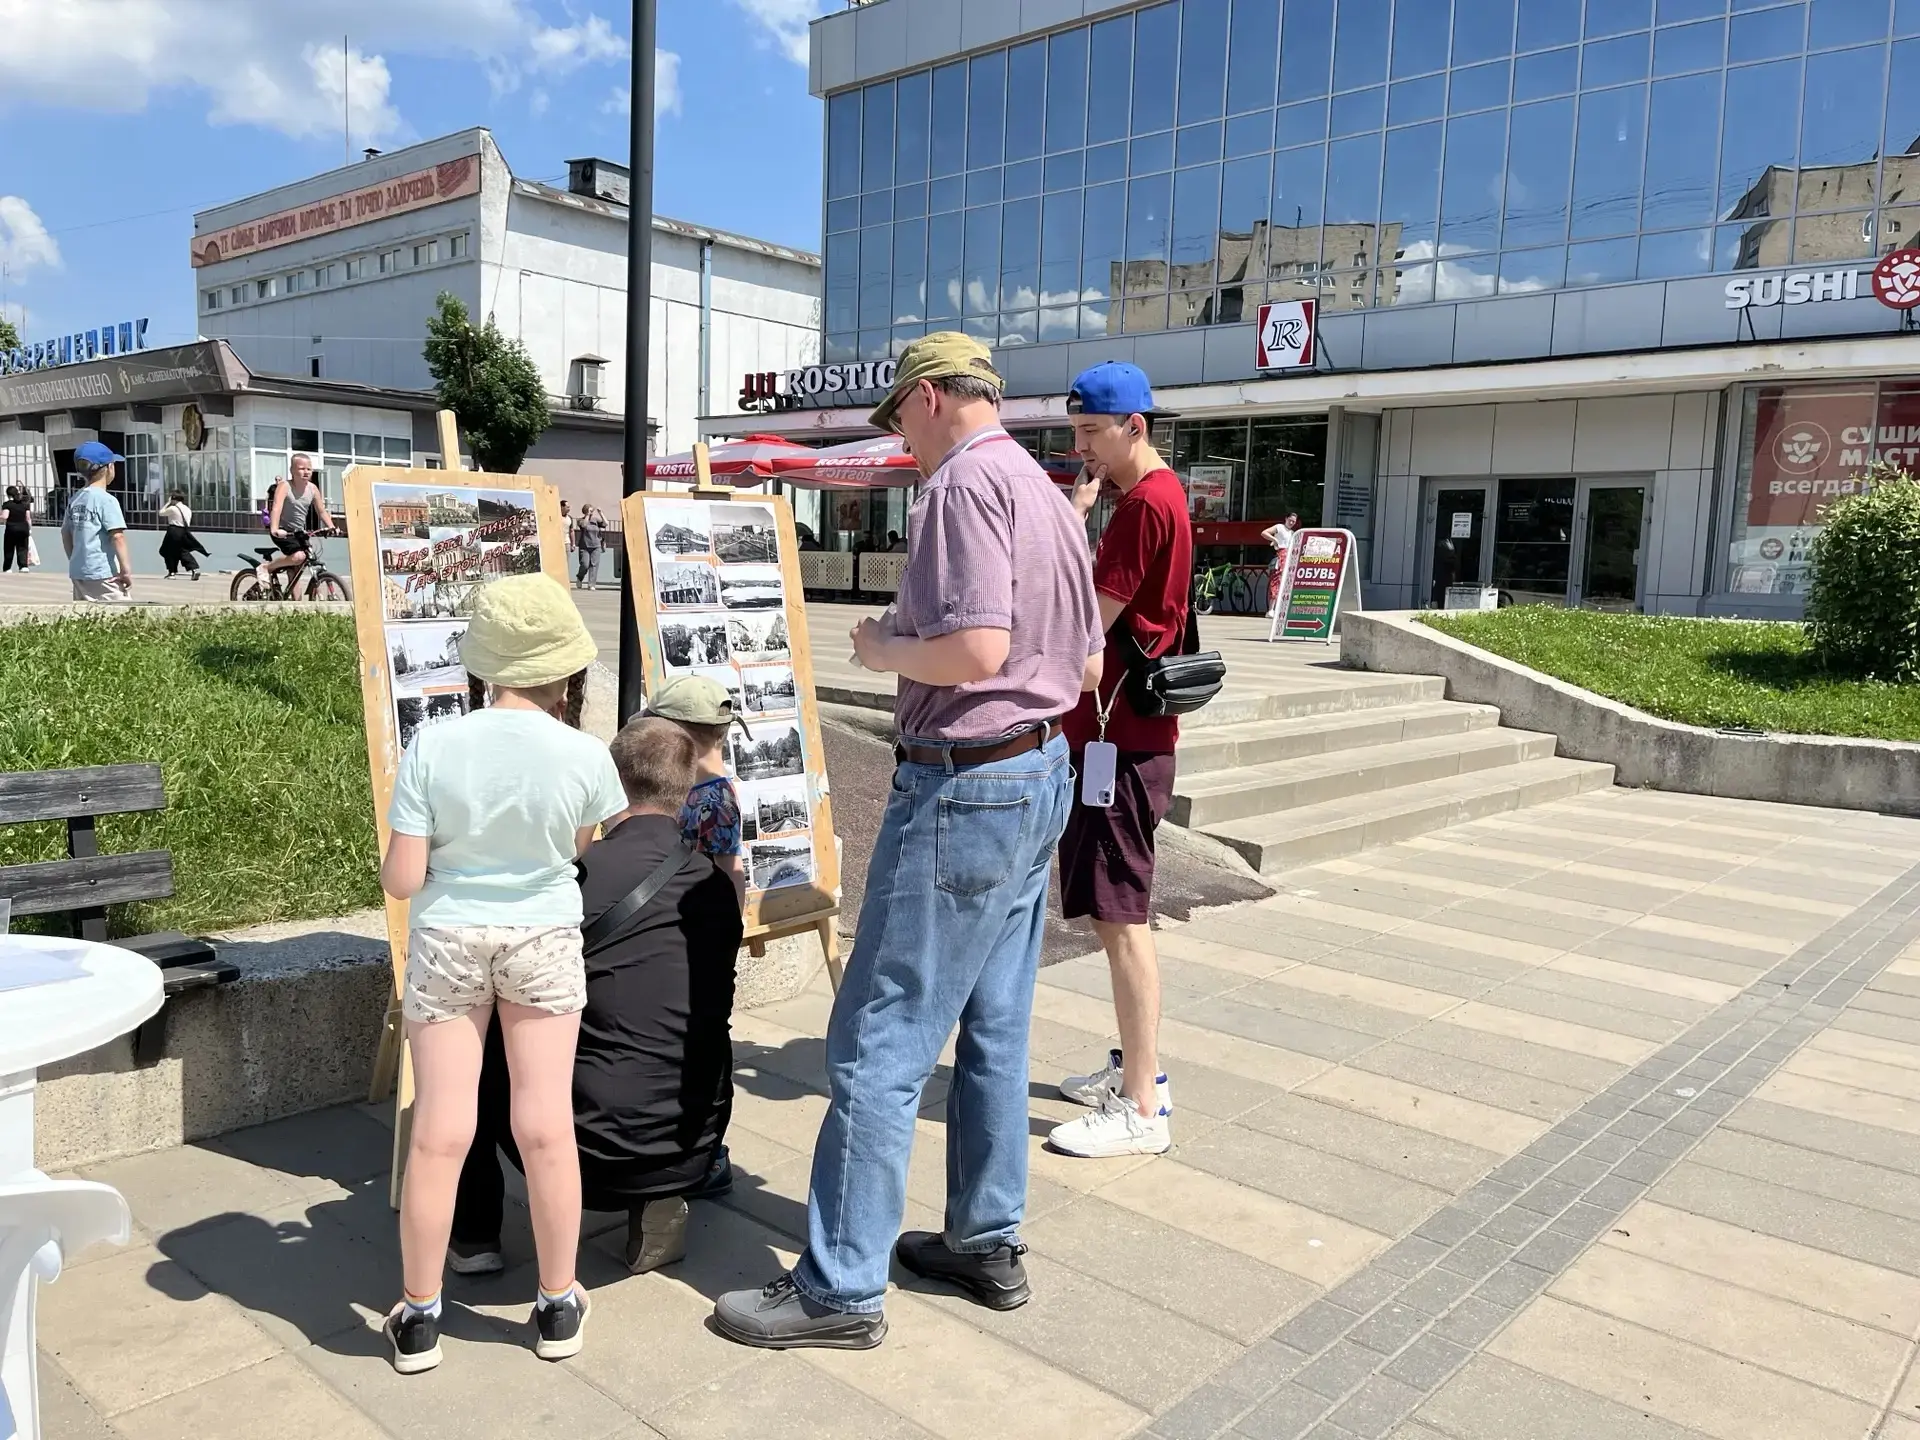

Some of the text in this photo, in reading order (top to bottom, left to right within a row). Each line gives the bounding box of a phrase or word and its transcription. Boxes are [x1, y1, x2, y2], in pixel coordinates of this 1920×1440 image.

[339, 200, 351, 221] ТЫ
[1725, 270, 1858, 309] SUSHI
[1267, 319, 1303, 351] R
[784, 360, 897, 395] ROSTIC
[11, 373, 112, 406] ВСЕ НОВИНКИ КИНО
[1841, 425, 1920, 445] СУШИ
[815, 456, 888, 467] ROSTIC'S
[1839, 447, 1920, 467] МАСТ
[655, 463, 696, 476] ROSTIC
[1769, 480, 1854, 497] всегда
[1296, 568, 1336, 579] ОБУВЬ
